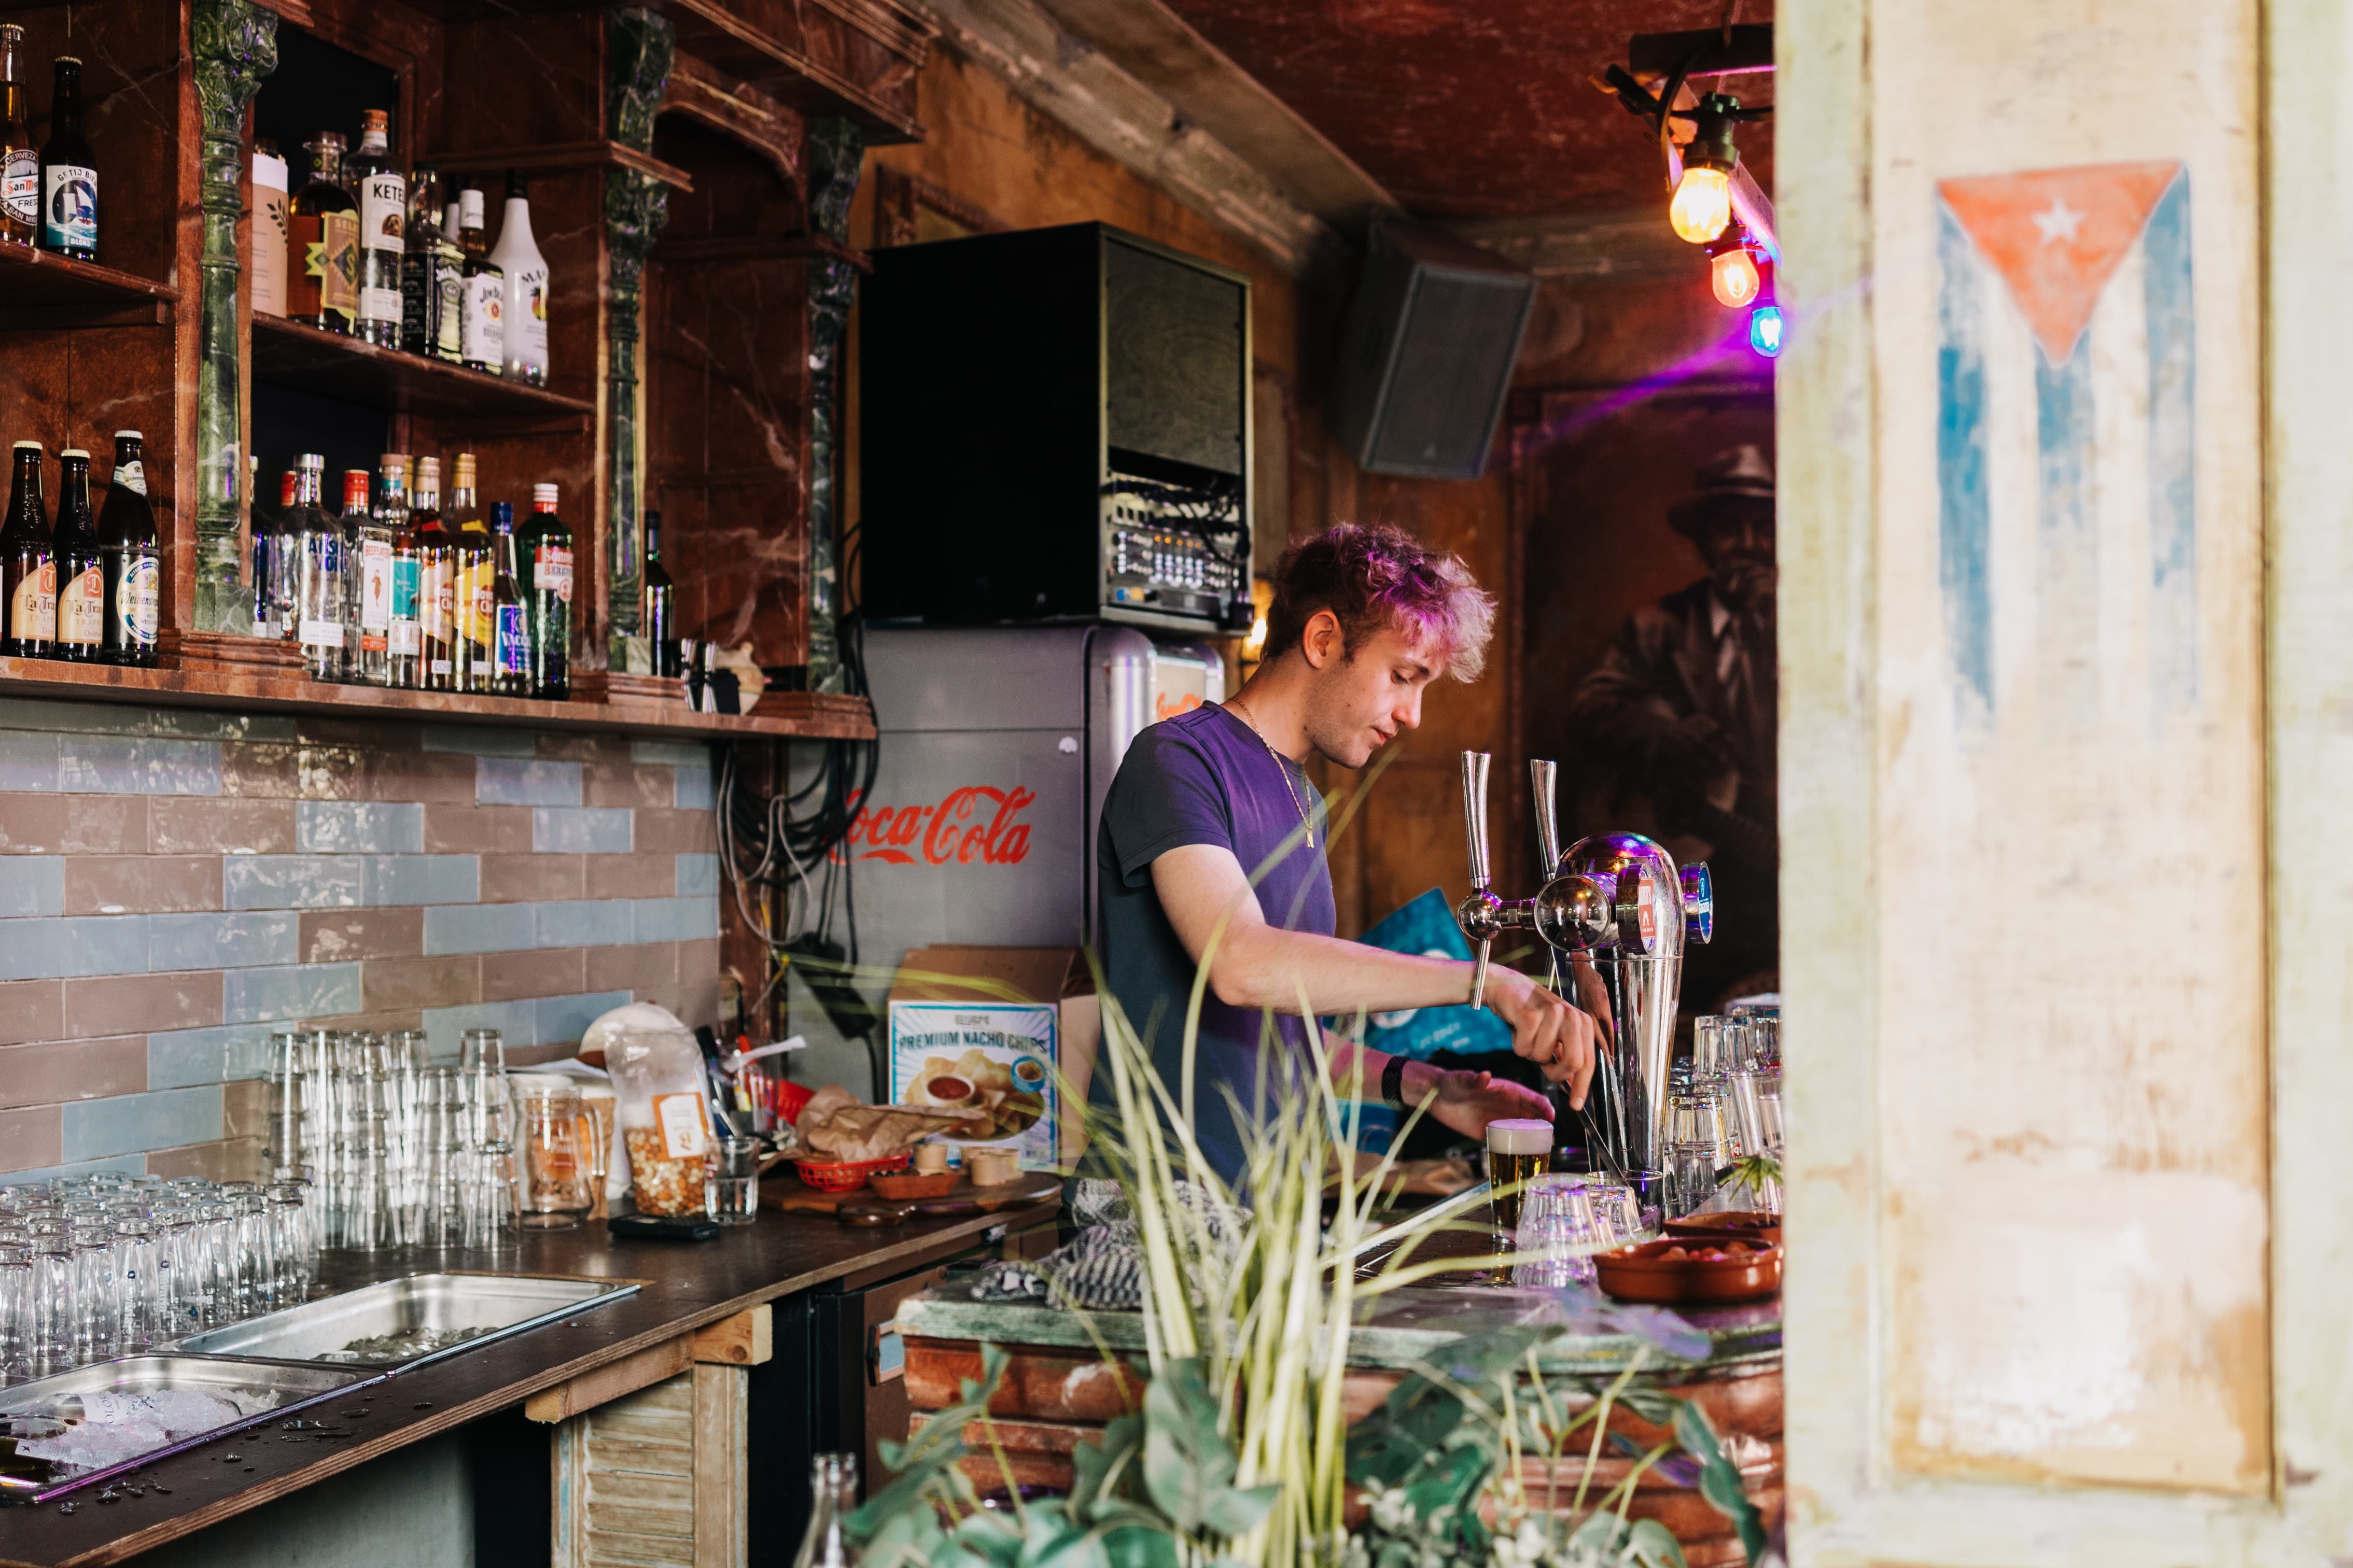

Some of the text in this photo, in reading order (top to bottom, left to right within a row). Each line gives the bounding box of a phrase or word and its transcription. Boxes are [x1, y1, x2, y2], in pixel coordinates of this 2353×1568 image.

[5, 152, 36, 165] CERVEZA
[58, 169, 82, 181] GETIJ
[8, 206, 24, 220] SAN
[71, 237, 91, 247] BLOND
[365, 544, 389, 560] BEEFEATER
[899, 1030, 1047, 1054] PREMIUM NACHO CHIPS
